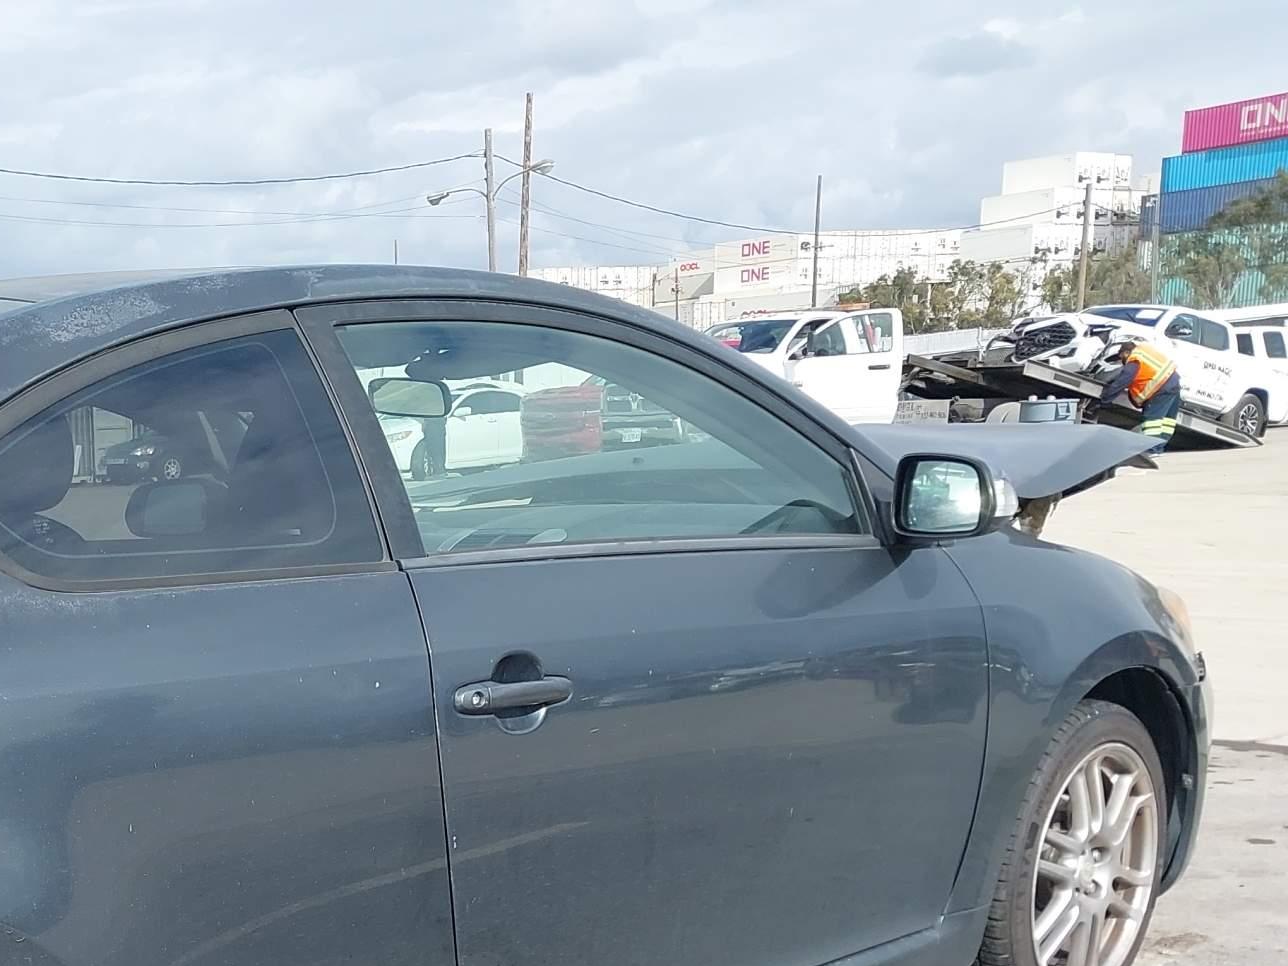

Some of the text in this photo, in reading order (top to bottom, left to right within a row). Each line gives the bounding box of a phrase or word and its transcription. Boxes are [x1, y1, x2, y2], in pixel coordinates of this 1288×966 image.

[1240, 97, 1288, 131] ON
[741, 240, 770, 258] ONE
[740, 266, 770, 284] ONE
